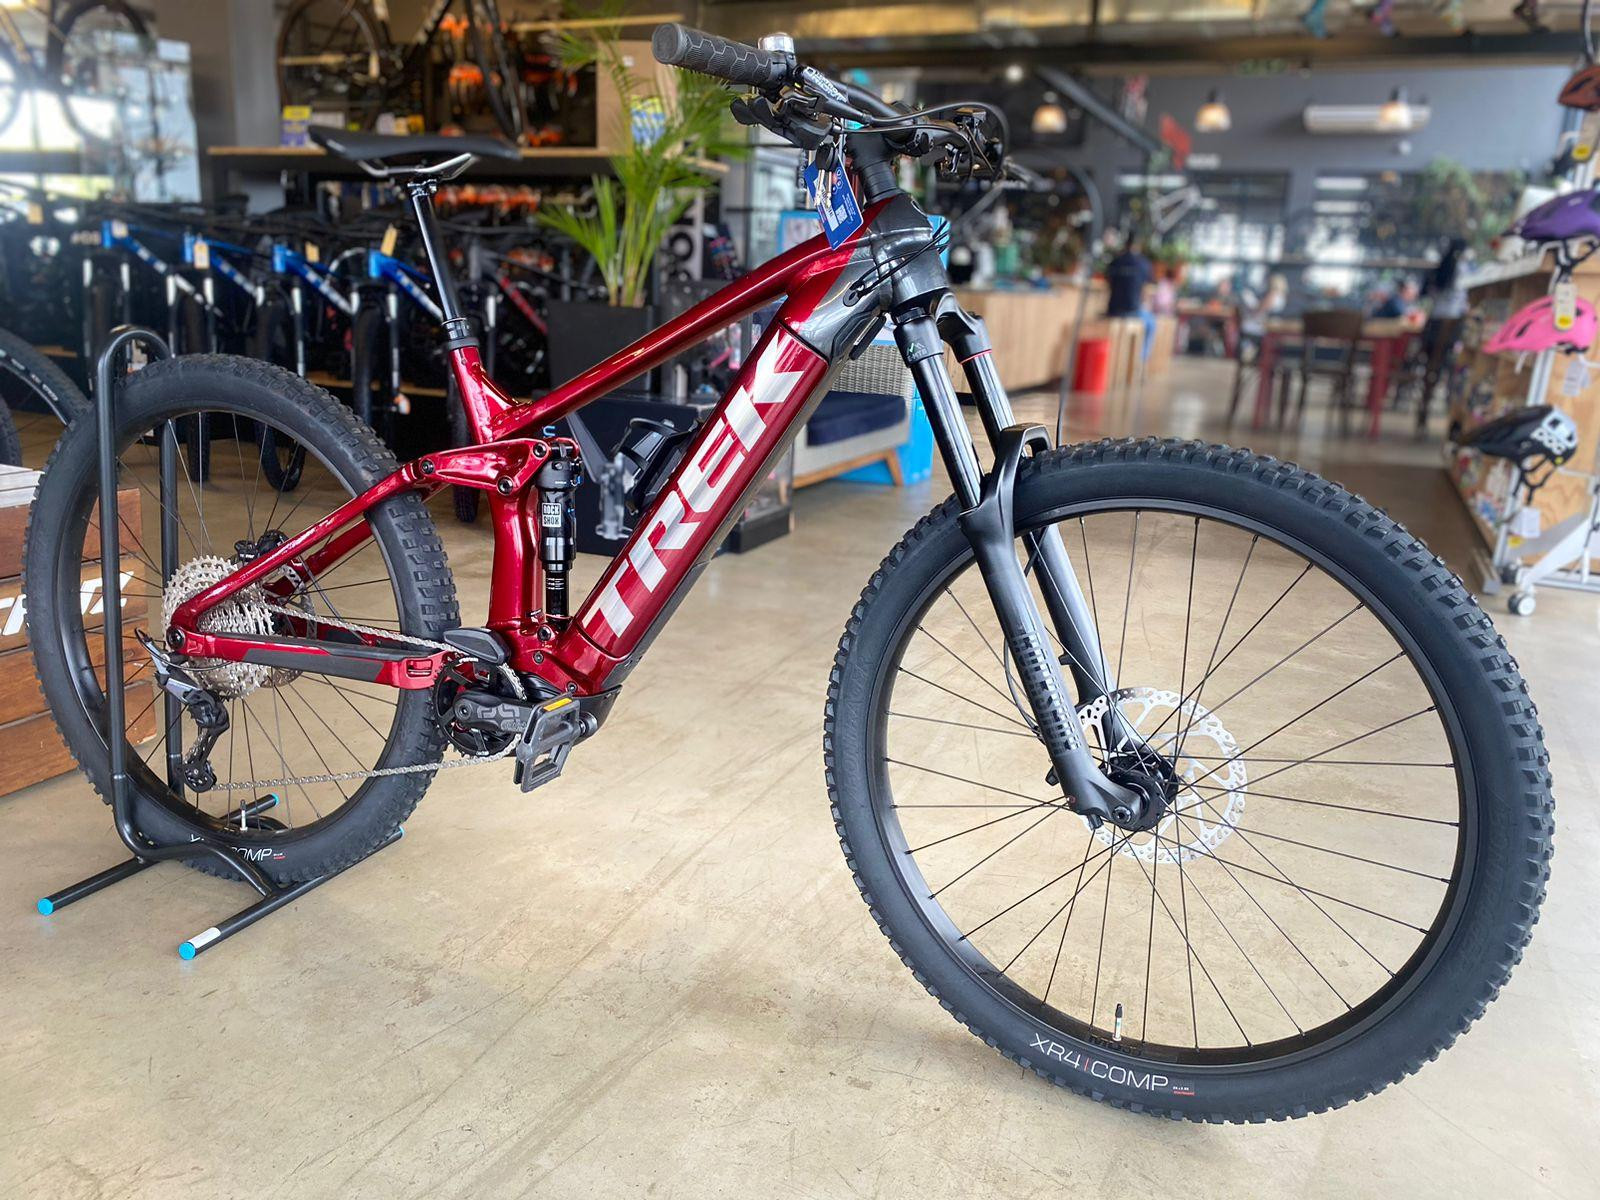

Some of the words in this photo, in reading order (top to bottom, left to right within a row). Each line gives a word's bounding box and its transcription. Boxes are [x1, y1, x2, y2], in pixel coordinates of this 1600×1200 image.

[543, 504, 560, 515] ROCK
[581, 329, 805, 638] TREK
[1029, 1032, 1082, 1069] XR4
[1091, 1060, 1169, 1091] COMP
